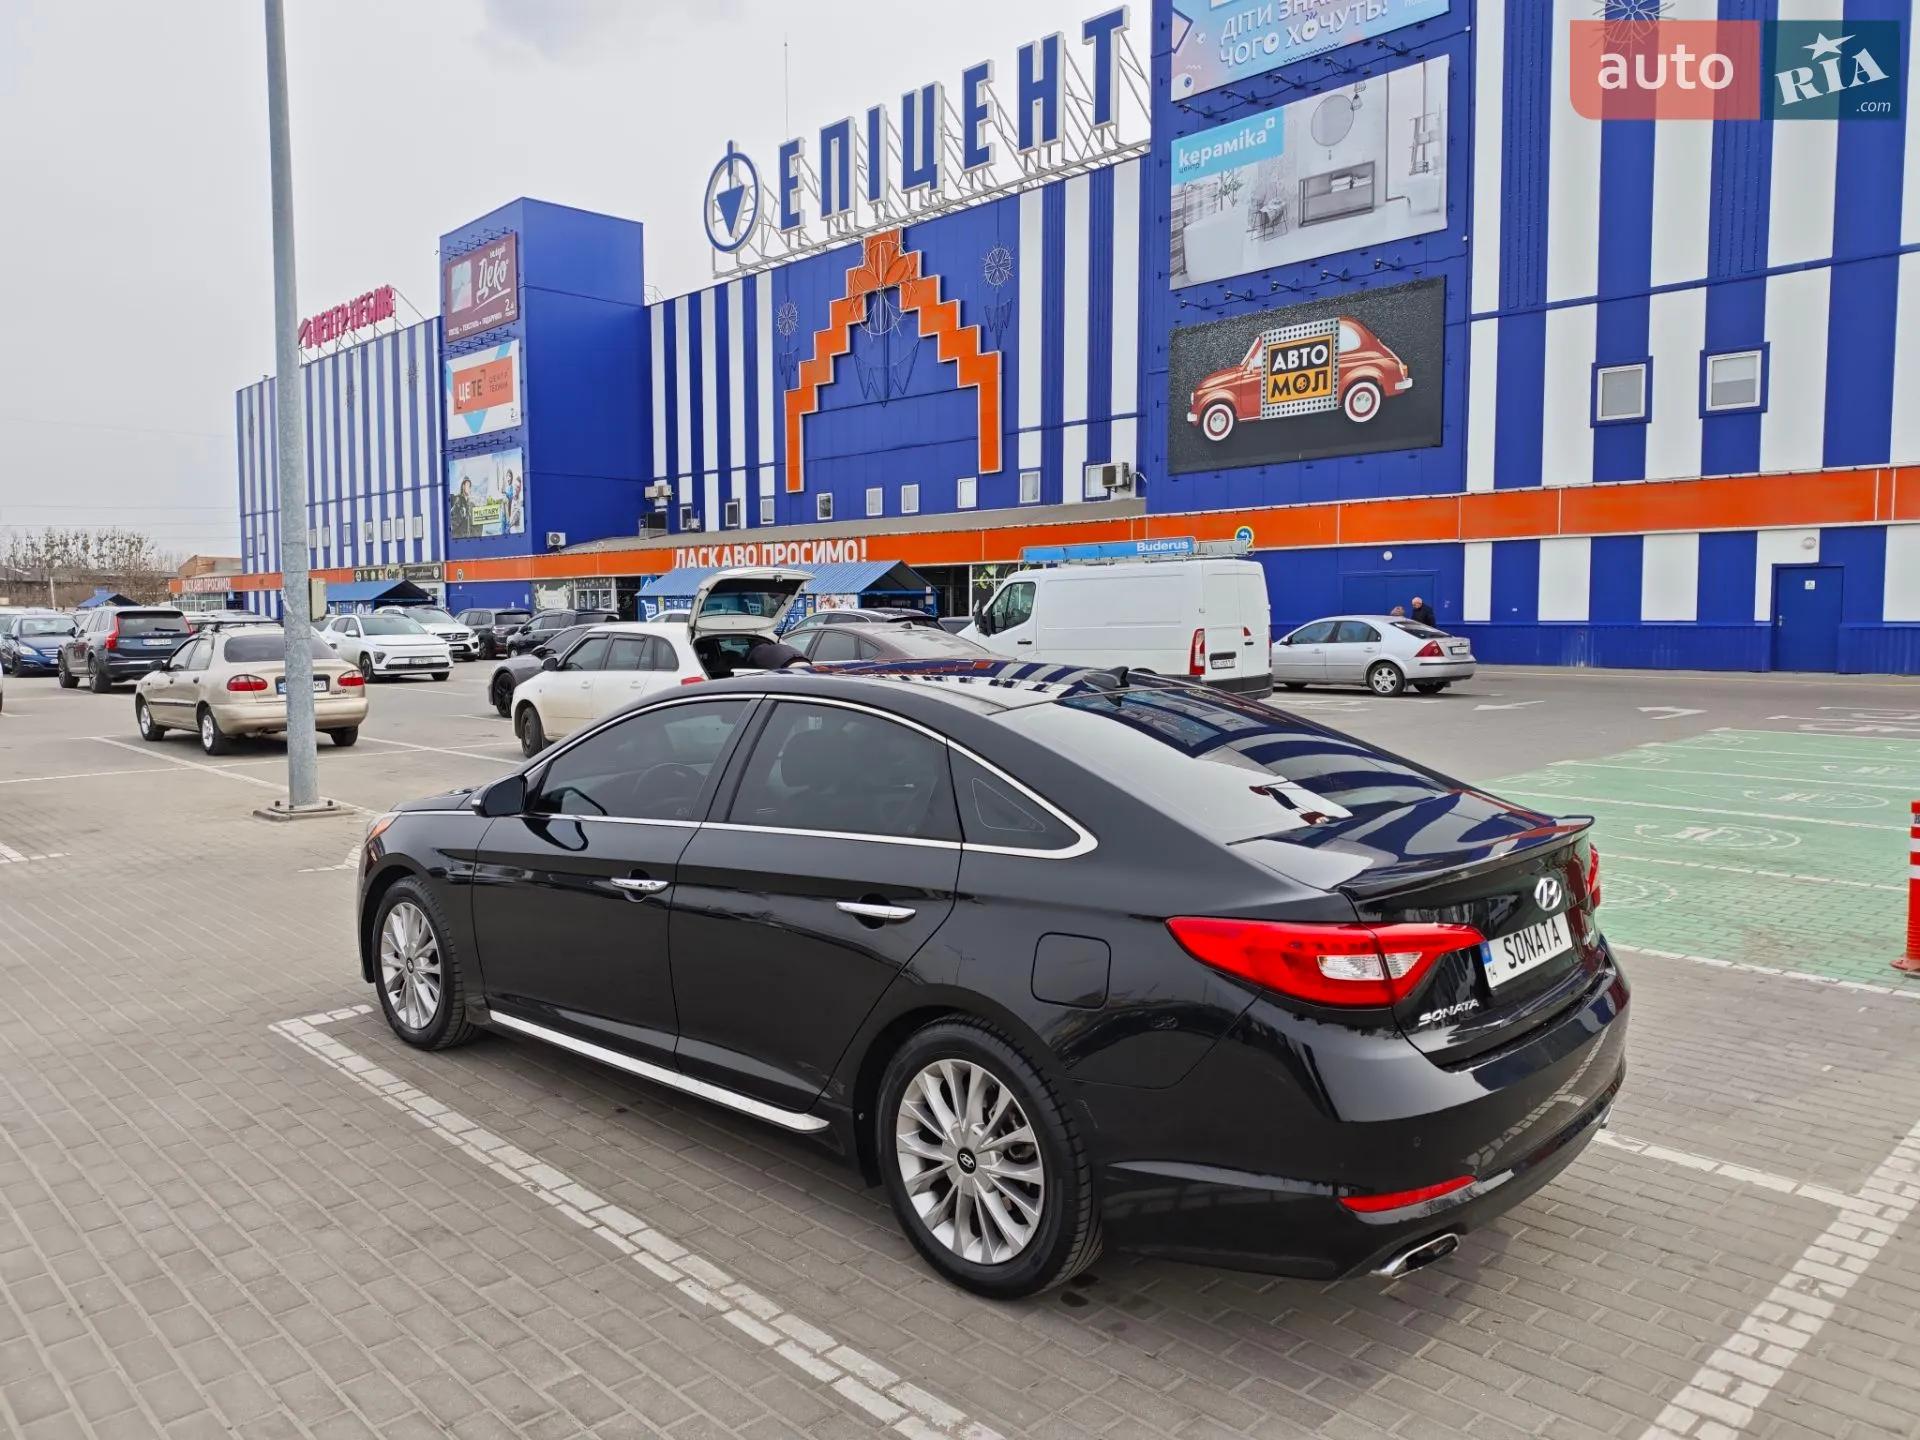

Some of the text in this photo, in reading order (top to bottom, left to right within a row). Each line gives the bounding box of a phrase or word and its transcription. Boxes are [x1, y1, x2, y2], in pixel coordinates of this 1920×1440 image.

[1219, 3, 1272, 46] ДІТИ
[1219, 0, 1389, 66] ЧОГО ХОЧУТЬ!
[779, 4, 1131, 233] ЕПІЦЕНТ
[1272, 344, 1328, 372] АВТО
[1270, 369, 1328, 398] МОЛ
[675, 537, 868, 569] ЛАСКАВО ПРОСИМО!
[1136, 539, 1189, 552] Buderus
[1503, 918, 1563, 970] SONATA
[1418, 998, 1480, 1027] SONATA
